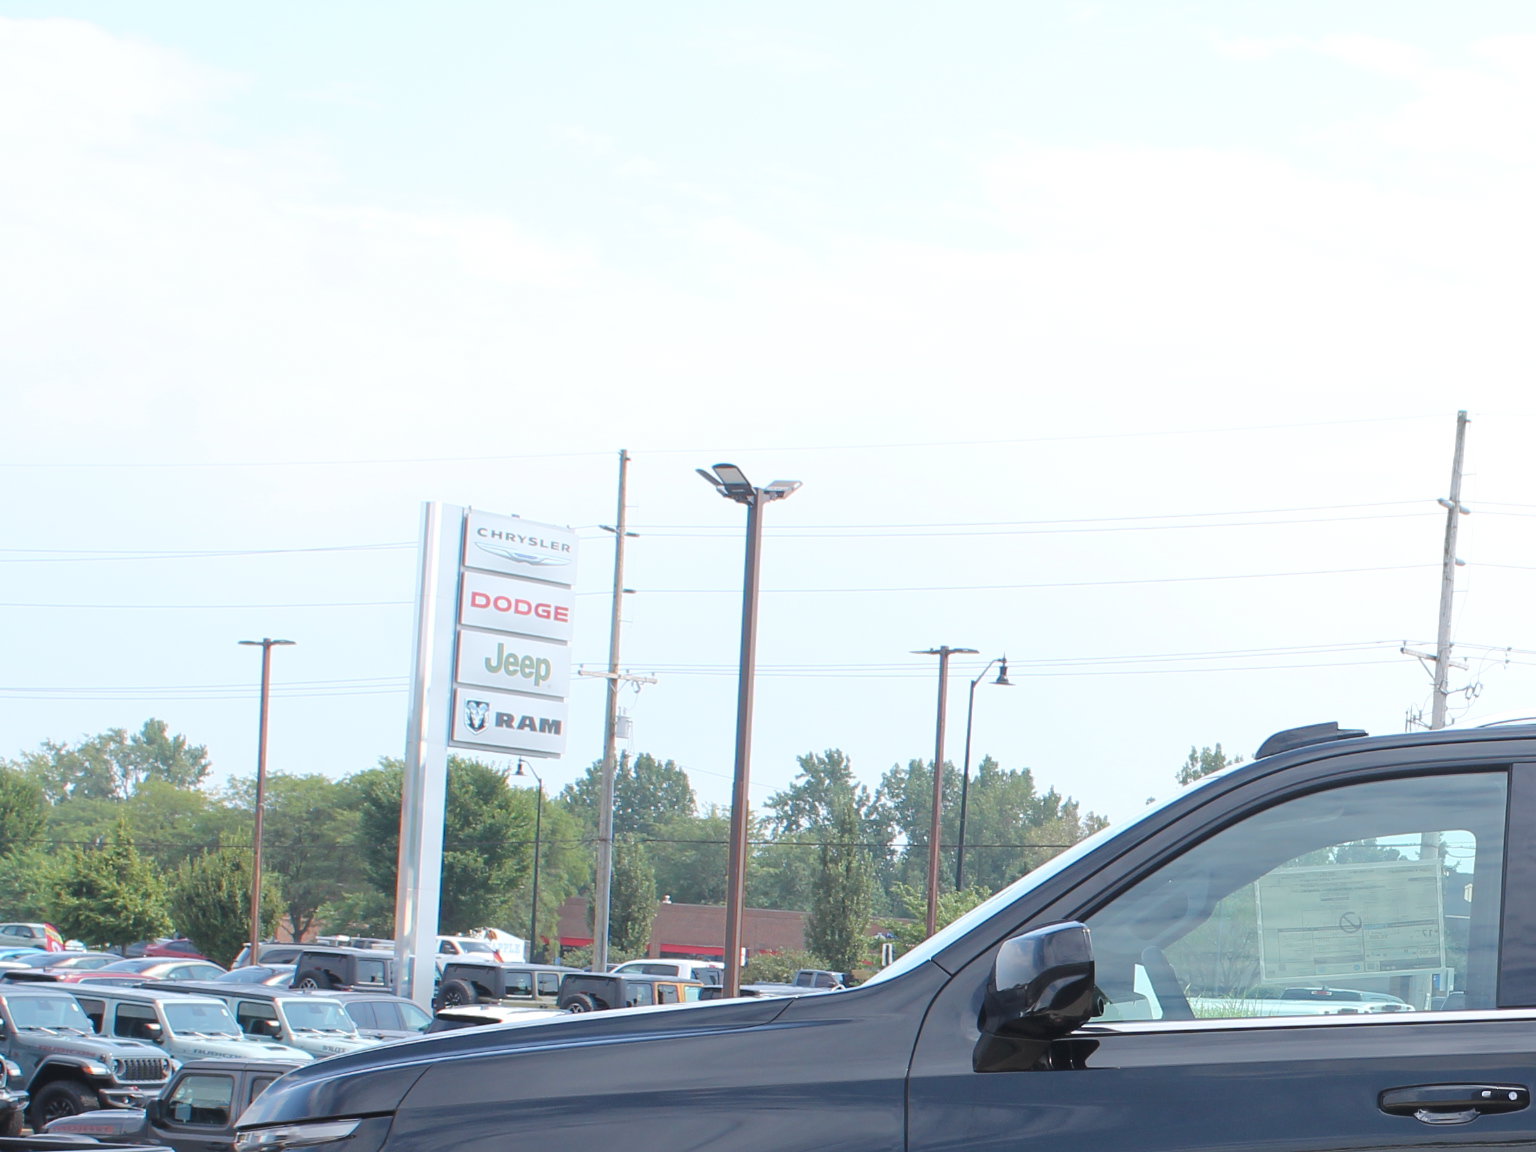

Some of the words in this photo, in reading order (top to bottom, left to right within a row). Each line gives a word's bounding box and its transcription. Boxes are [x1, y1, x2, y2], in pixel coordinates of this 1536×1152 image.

[476, 527, 571, 553] CHRYSLER
[470, 591, 569, 622] DODGE
[484, 642, 551, 687] Jeep
[495, 711, 562, 735] RAM
